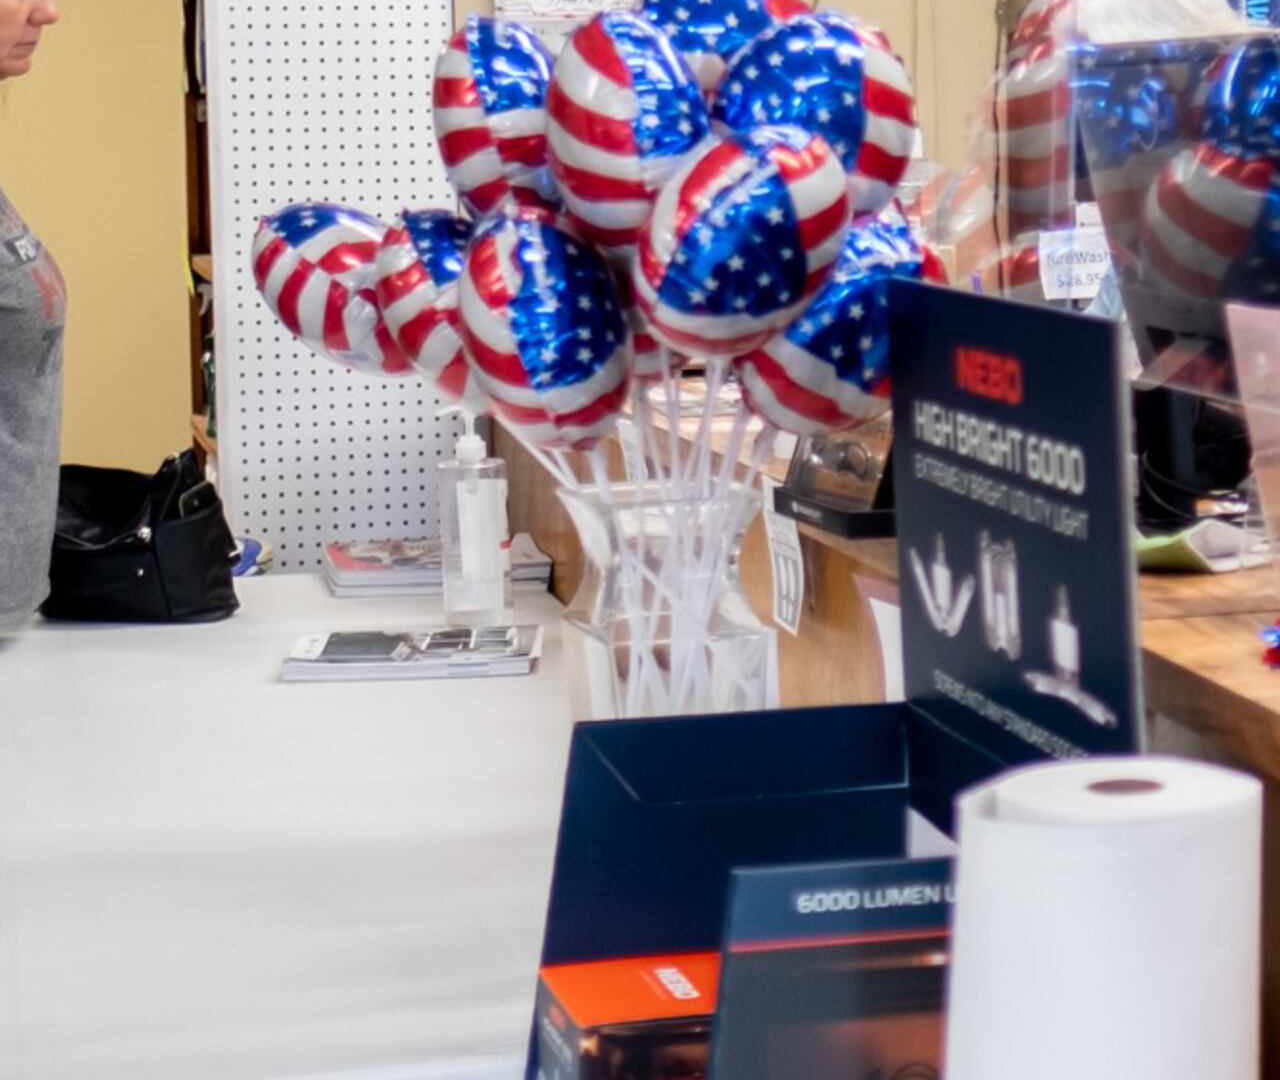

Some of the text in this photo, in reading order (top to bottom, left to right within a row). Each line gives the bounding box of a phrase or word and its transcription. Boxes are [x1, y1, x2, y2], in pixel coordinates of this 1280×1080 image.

[955, 345, 1024, 407] NEBO
[915, 400, 1087, 497] HIGH BRIGHT 6000
[795, 890, 861, 914] 6000
[862, 885, 940, 909] LUMEN
[653, 966, 701, 1001] NEBO
